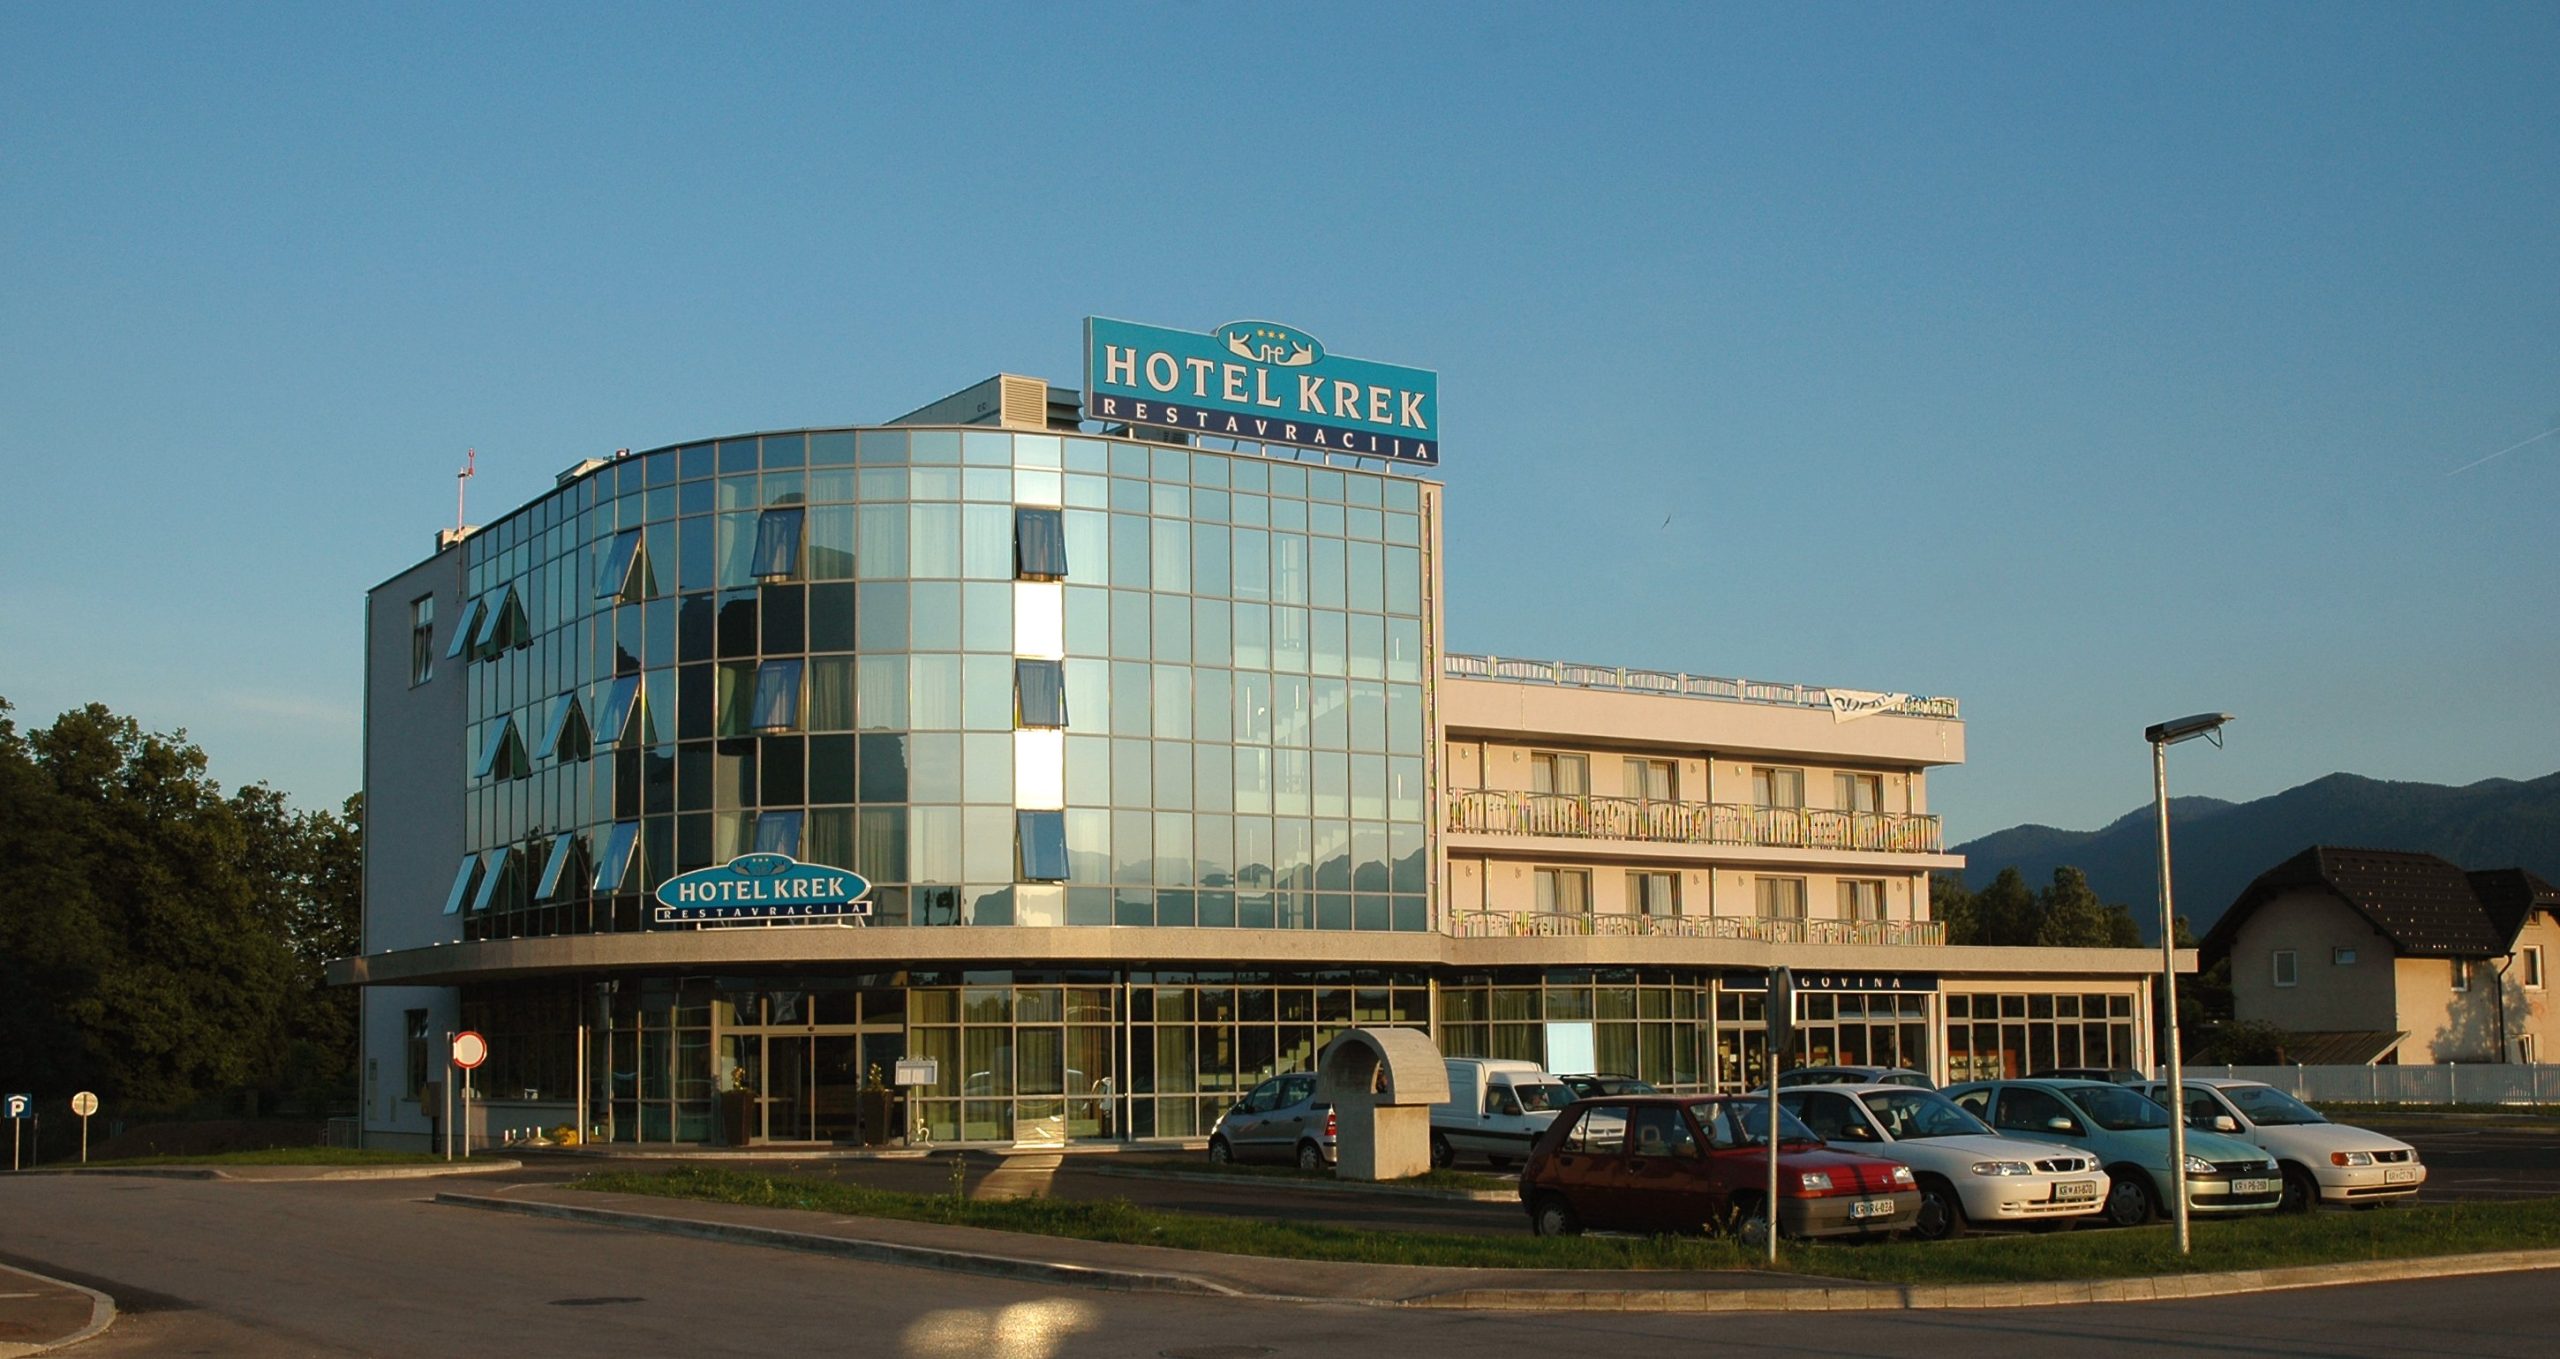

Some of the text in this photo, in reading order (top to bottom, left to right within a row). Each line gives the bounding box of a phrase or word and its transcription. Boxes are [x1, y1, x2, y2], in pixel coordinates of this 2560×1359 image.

[1104, 344, 1282, 408] HOTEL
[1298, 374, 1428, 430] KREK
[1103, 398, 1428, 459] RESTAVRACIJA
[679, 877, 845, 902] HOTEL KREK
[663, 904, 861, 919] RESTAVRACIJA
[11, 1101, 25, 1117] P
